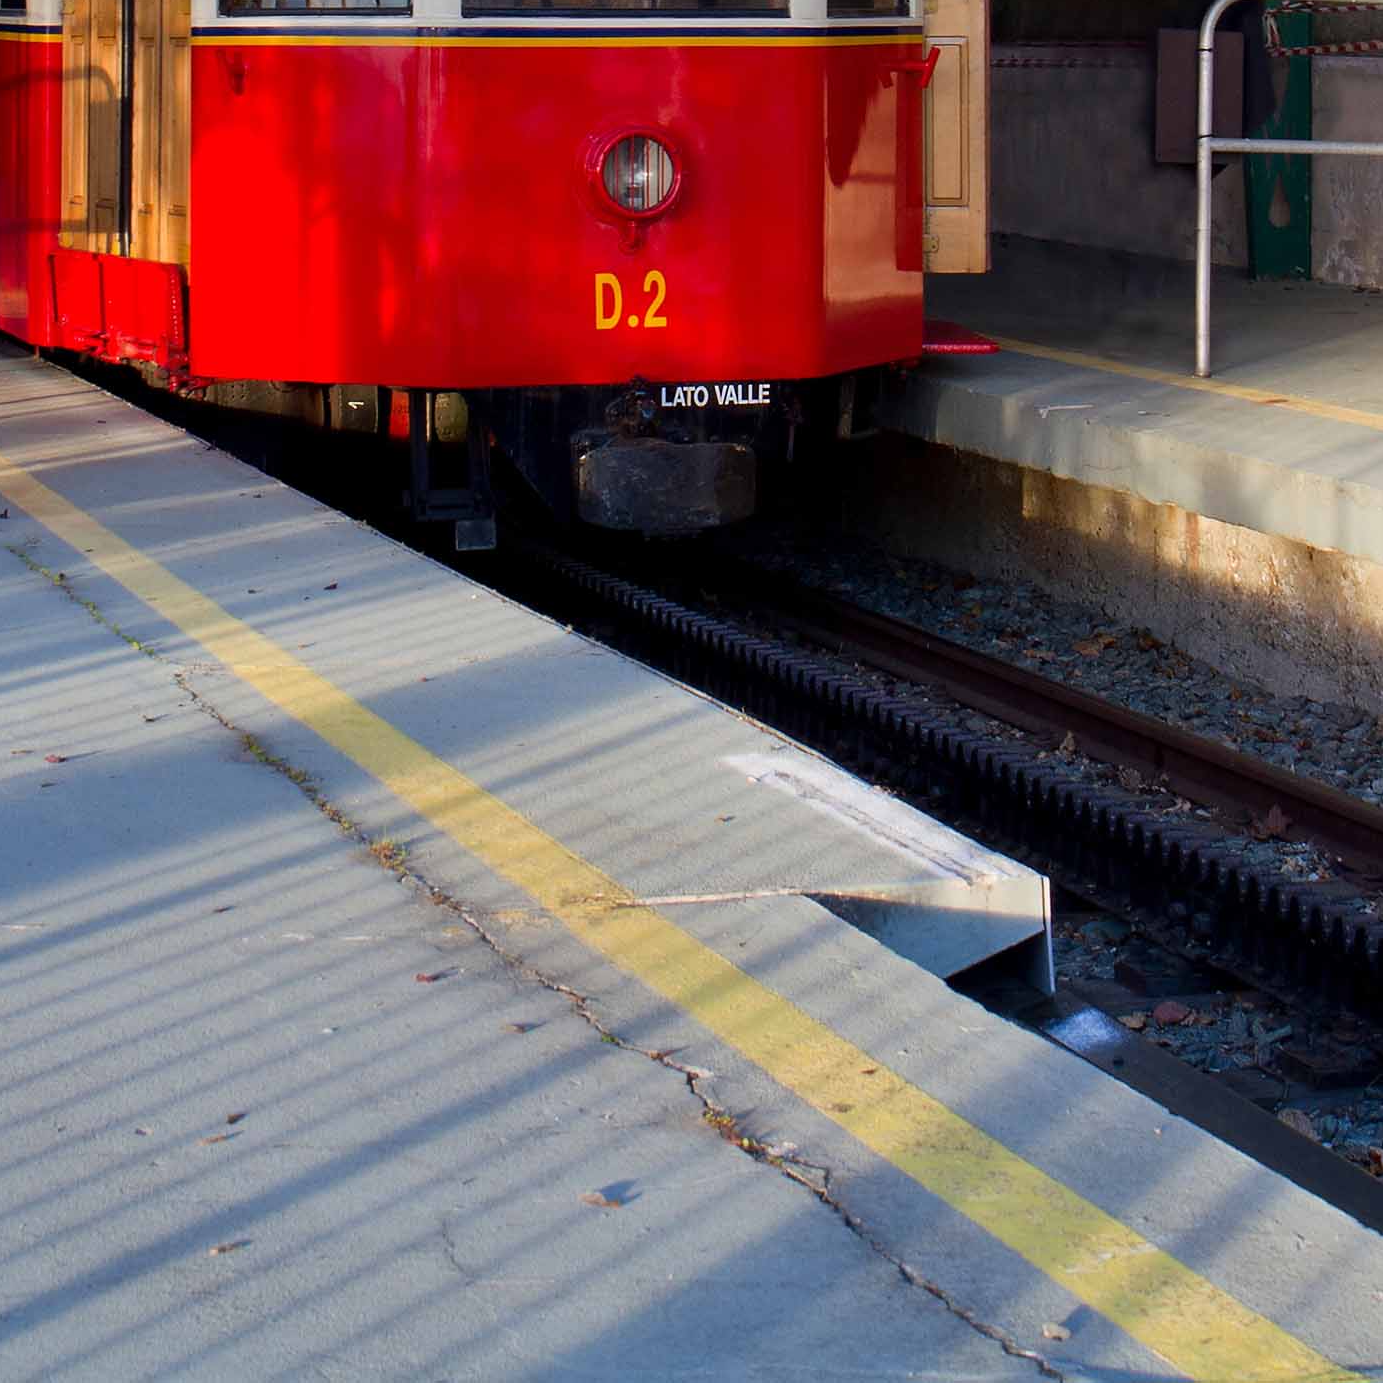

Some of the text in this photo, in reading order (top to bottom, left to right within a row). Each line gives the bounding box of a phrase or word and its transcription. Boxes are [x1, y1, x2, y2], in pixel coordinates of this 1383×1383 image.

[595, 270, 667, 330] D.2
[661, 383, 771, 407] LATO VALLE
